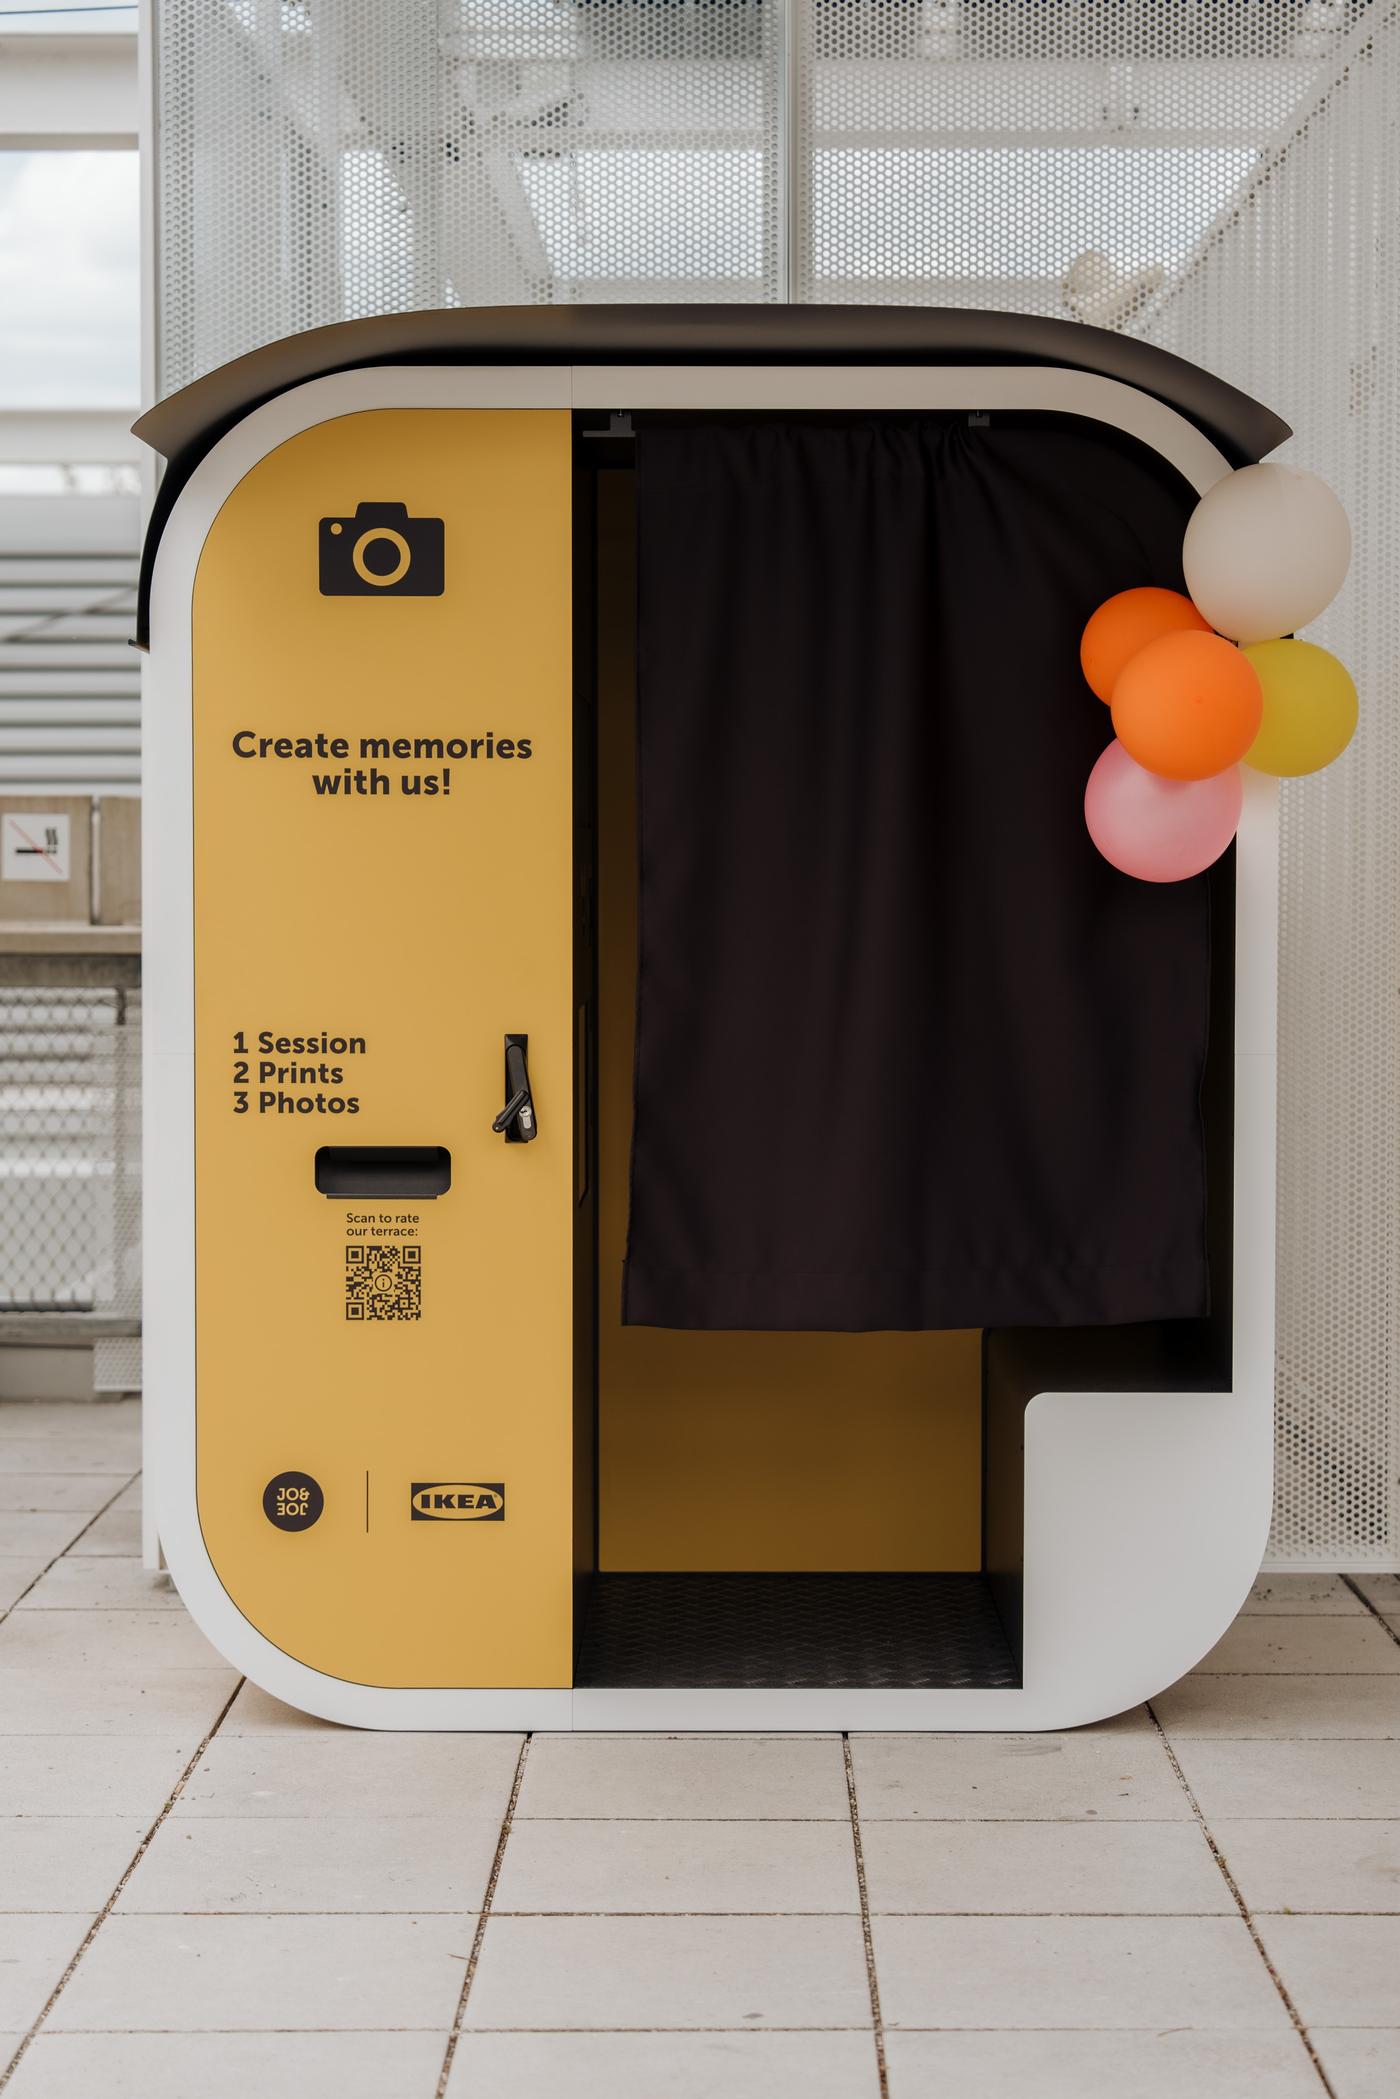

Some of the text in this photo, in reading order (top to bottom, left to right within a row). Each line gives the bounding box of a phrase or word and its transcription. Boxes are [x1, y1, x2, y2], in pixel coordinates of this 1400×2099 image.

[231, 731, 533, 759] Create memories
[312, 768, 451, 795] with us!
[233, 1031, 367, 1054] 1 Session
[233, 1061, 344, 1084] 2 Prints
[233, 1091, 360, 1114] 3 Photos
[346, 1212, 420, 1223] Scan to rate
[346, 1227, 418, 1236] our terrace:
[277, 1487, 310, 1501] JO&
[421, 1494, 497, 1509] IKEA
